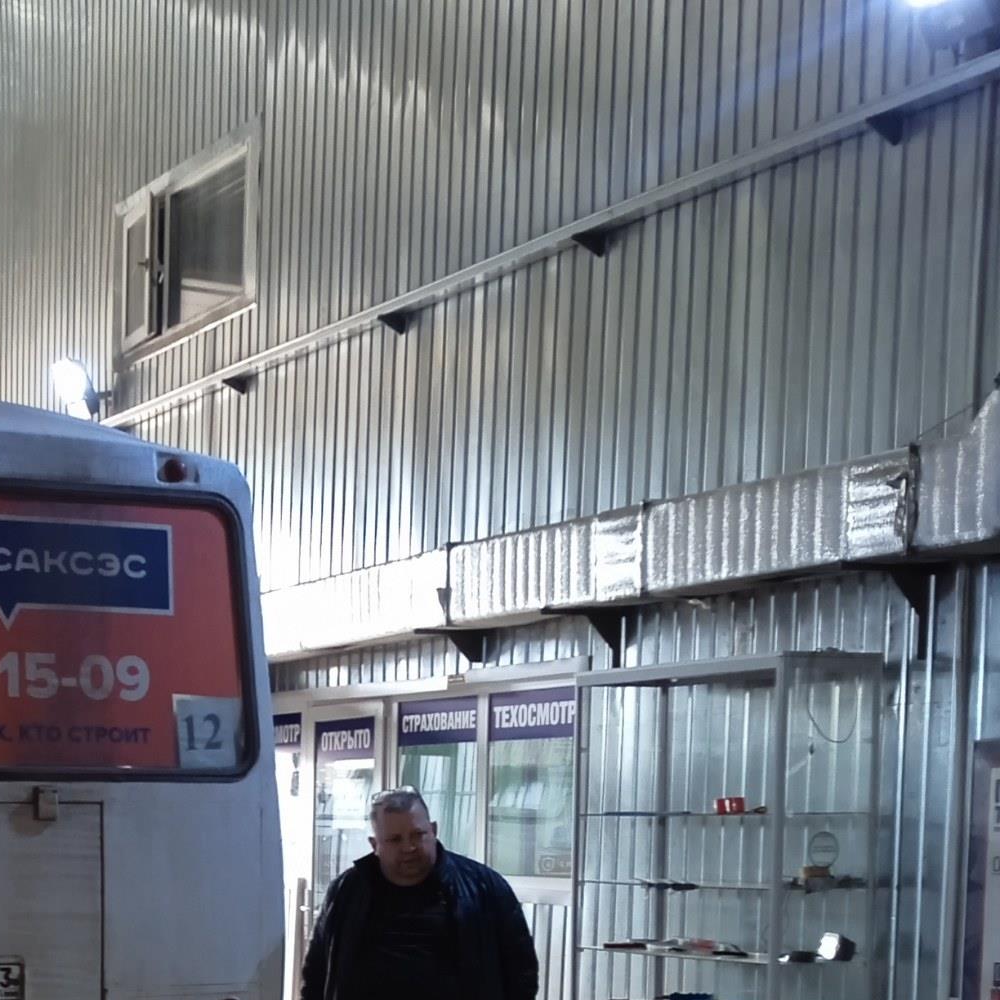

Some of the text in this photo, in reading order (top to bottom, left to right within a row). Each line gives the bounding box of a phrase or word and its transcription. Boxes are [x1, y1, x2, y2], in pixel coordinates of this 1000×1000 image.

[402, 709, 477, 734] СТРАХОВАНИЕ
[493, 700, 577, 729] ТЕХОСМОТР
[18, 724, 61, 743] КТО
[67, 726, 152, 745] СТРОИТ
[182, 712, 223, 751] 12
[320, 728, 371, 753] ОТКРЫТО
